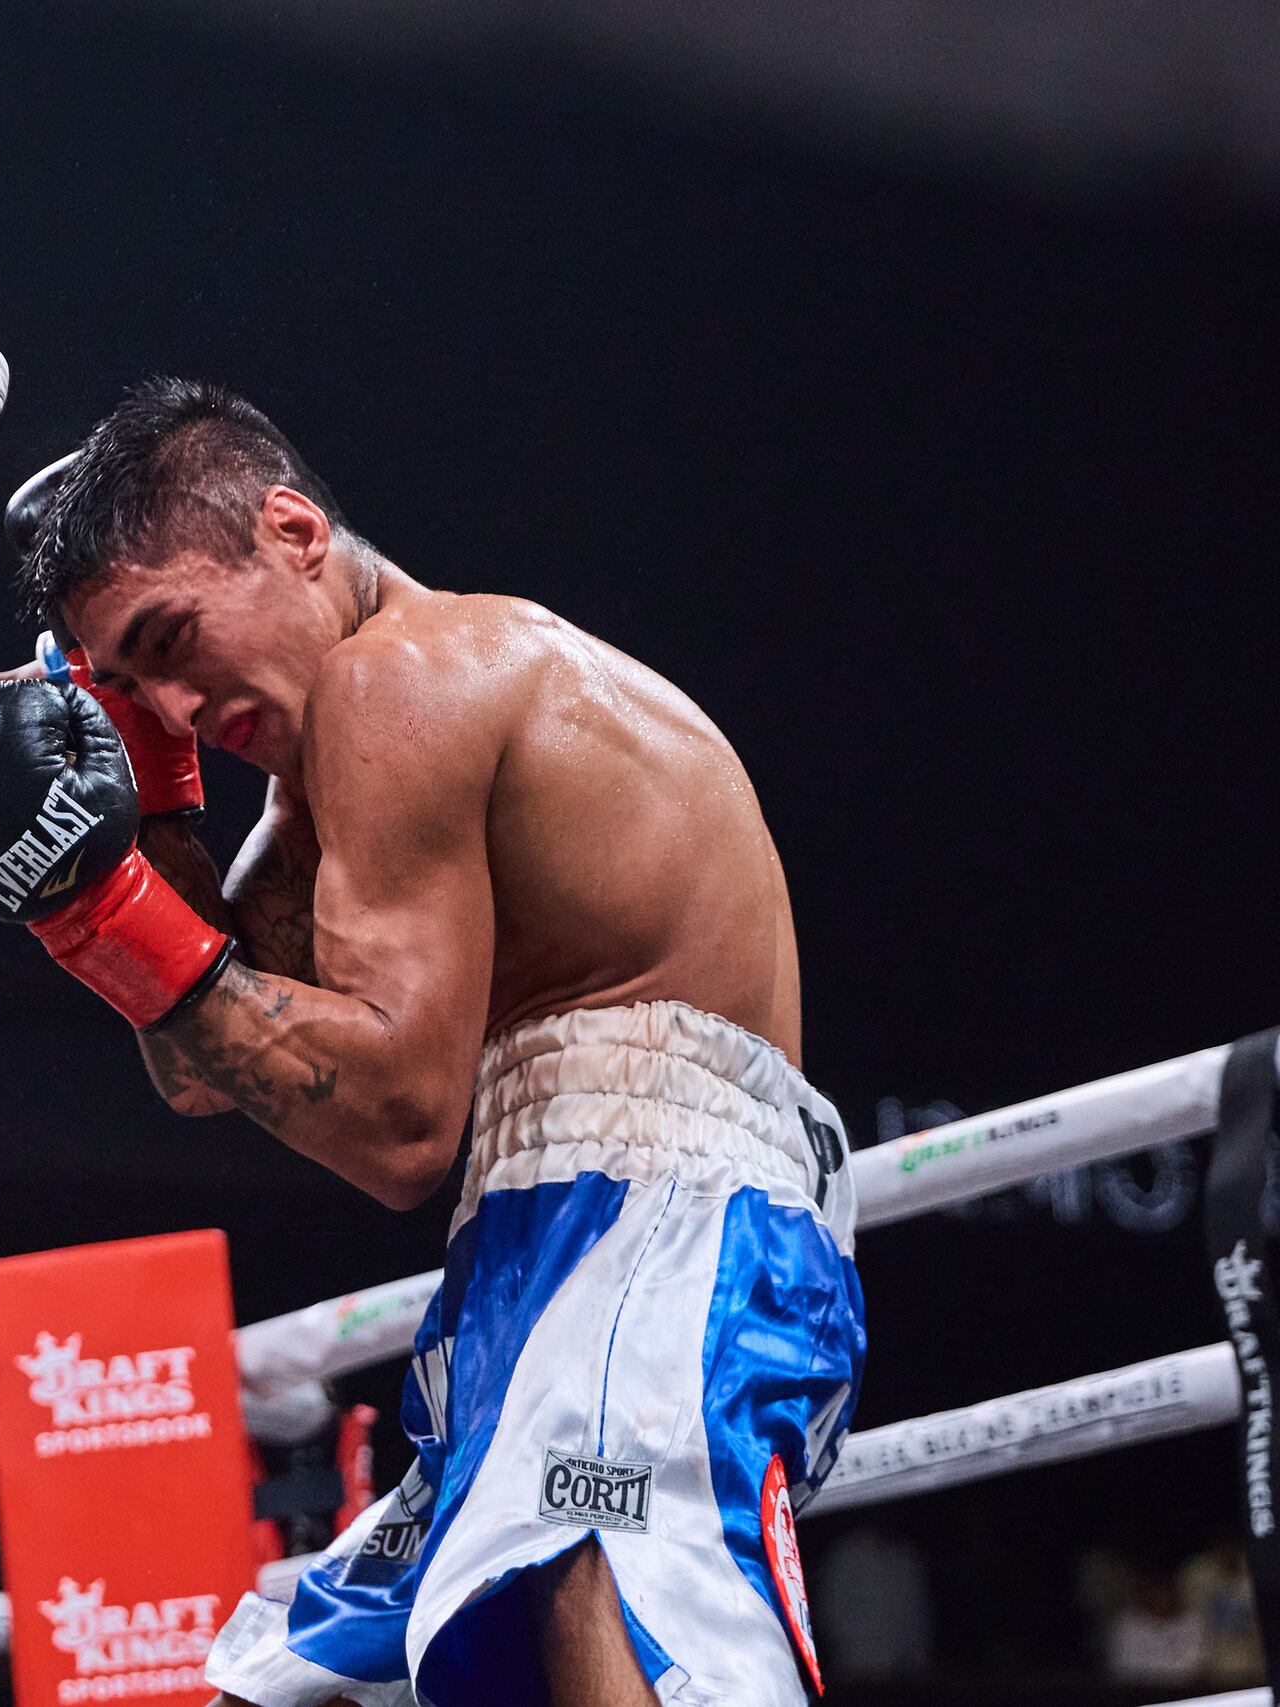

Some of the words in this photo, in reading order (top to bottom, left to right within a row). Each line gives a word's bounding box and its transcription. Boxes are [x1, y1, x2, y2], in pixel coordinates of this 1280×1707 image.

[29, 1346, 196, 1406] DRAFT
[52, 1378, 196, 1427] KINGS
[34, 1412, 214, 1459] SPORTSBOOK
[545, 1464, 649, 1521] CORTI
[607, 1465, 635, 1477] SPORT
[52, 1594, 220, 1652] DRAFT
[75, 1627, 216, 1675] KINGS
